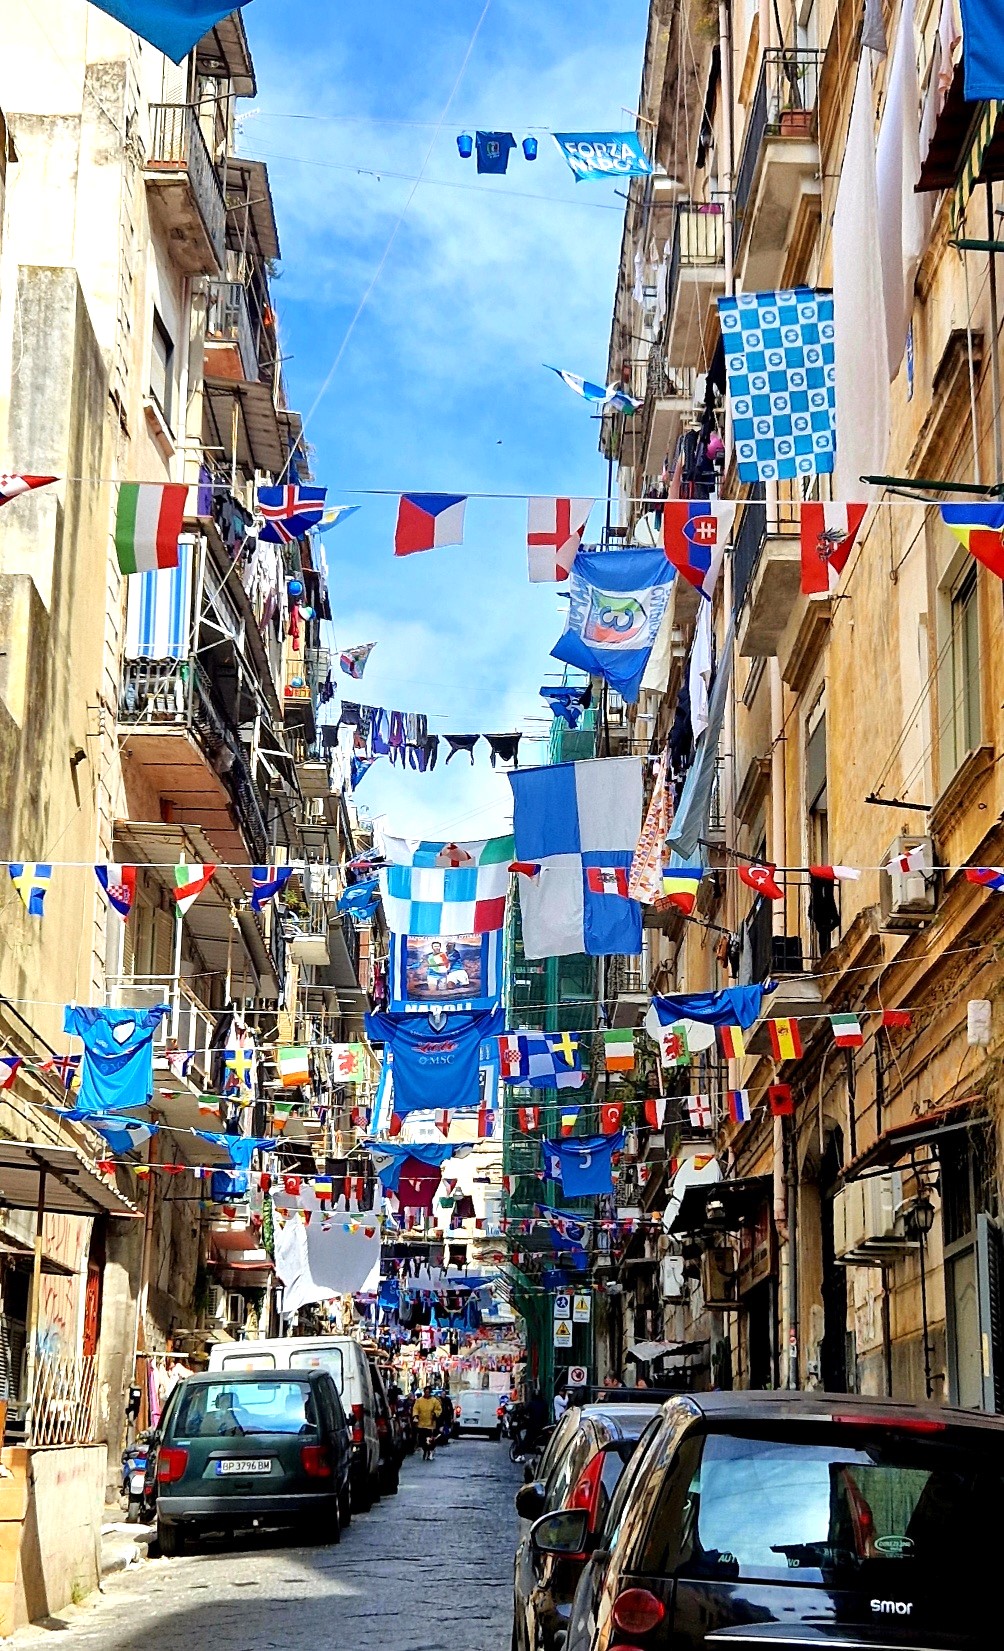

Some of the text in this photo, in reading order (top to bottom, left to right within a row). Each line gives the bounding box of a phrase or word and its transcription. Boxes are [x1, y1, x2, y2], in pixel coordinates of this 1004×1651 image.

[564, 142, 637, 159] FORZA
[430, 1055, 455, 1065] MSC
[222, 1462, 235, 1471] BP
